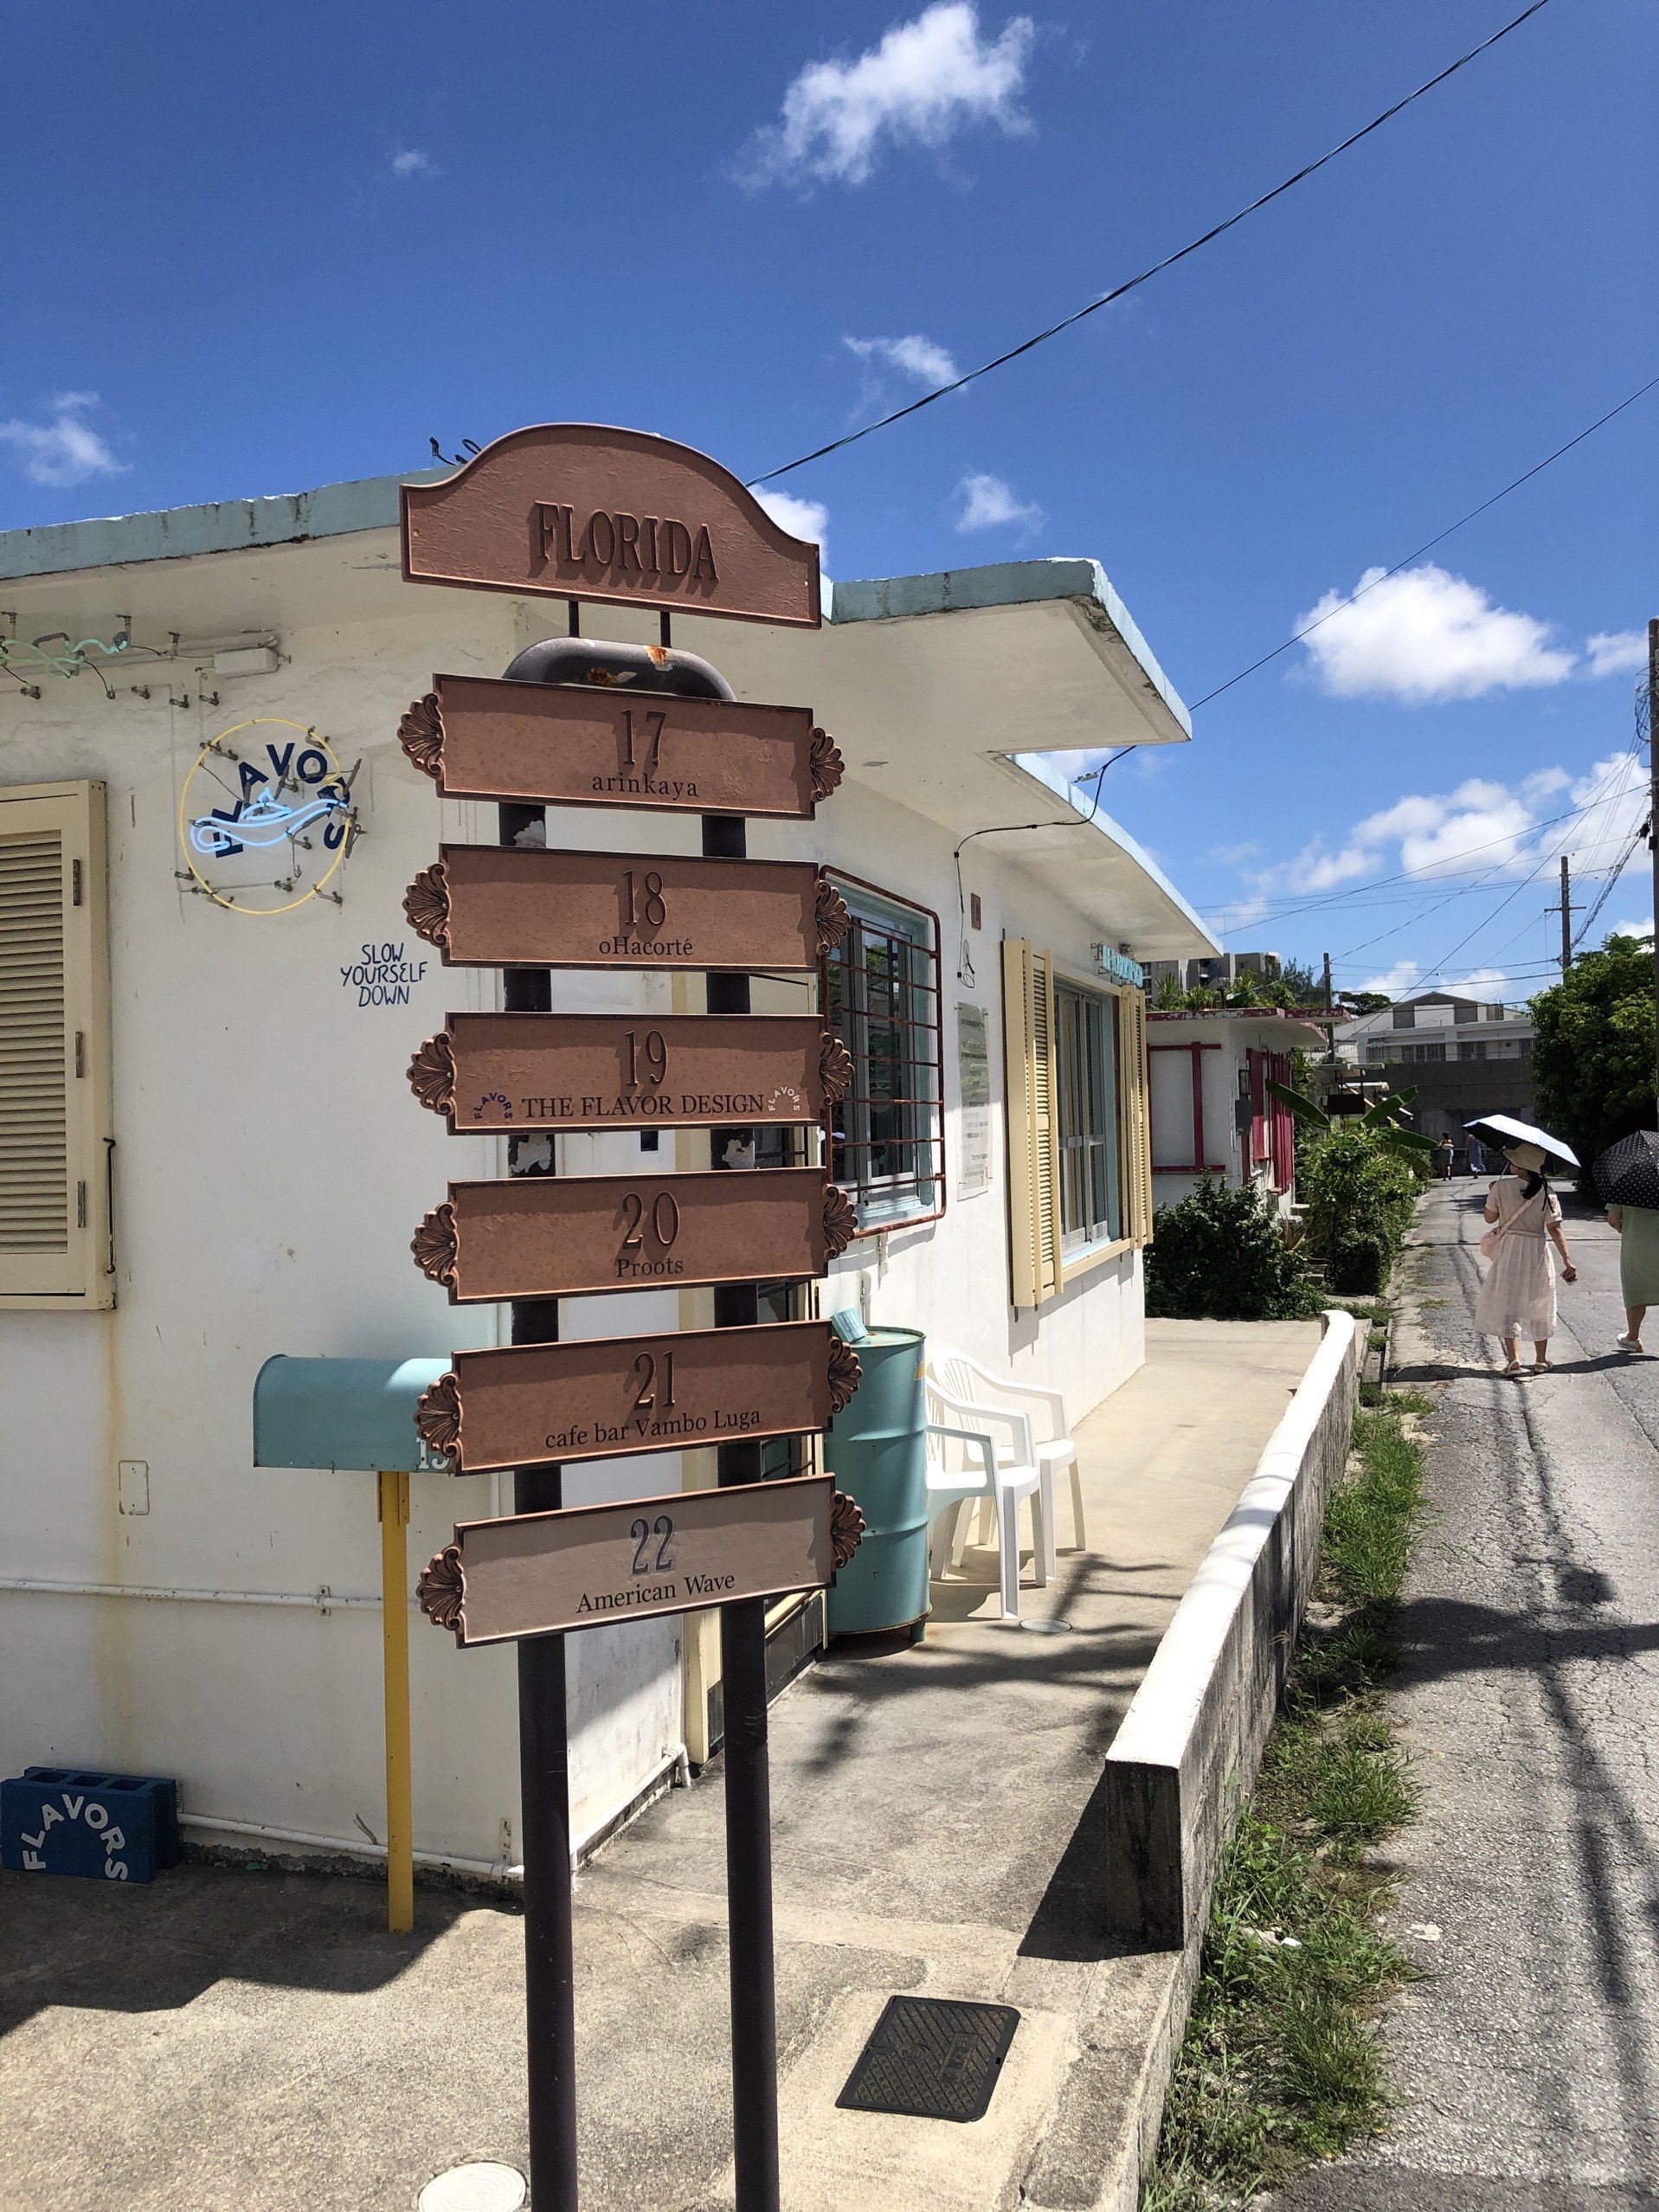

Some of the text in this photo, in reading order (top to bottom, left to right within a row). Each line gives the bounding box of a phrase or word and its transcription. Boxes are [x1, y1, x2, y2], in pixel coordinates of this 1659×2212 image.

[534, 500, 718, 582] FLORIDA
[622, 708, 666, 767] 17
[592, 773, 698, 801] arinkaya
[622, 870, 667, 927] 18
[360, 942, 404, 966] SLOW
[599, 936, 693, 956] oHacorté
[340, 961, 428, 987] YOURSELF
[358, 985, 410, 1007] DOWN
[624, 1028, 668, 1087] 19
[473, 1091, 513, 1120] FLAVORS
[522, 1093, 765, 1118] THE FLAVOR DESIGN
[767, 1085, 801, 1112] FLAVORS
[621, 1190, 680, 1251] 20
[616, 1257, 685, 1278] Proots
[633, 1350, 676, 1411] 21
[545, 1408, 762, 1450] cafe bar Vambo Luga
[629, 1514, 674, 1575] 22
[576, 1572, 735, 1614] American Wave
[20, 1793, 129, 1881] FLAVORS
